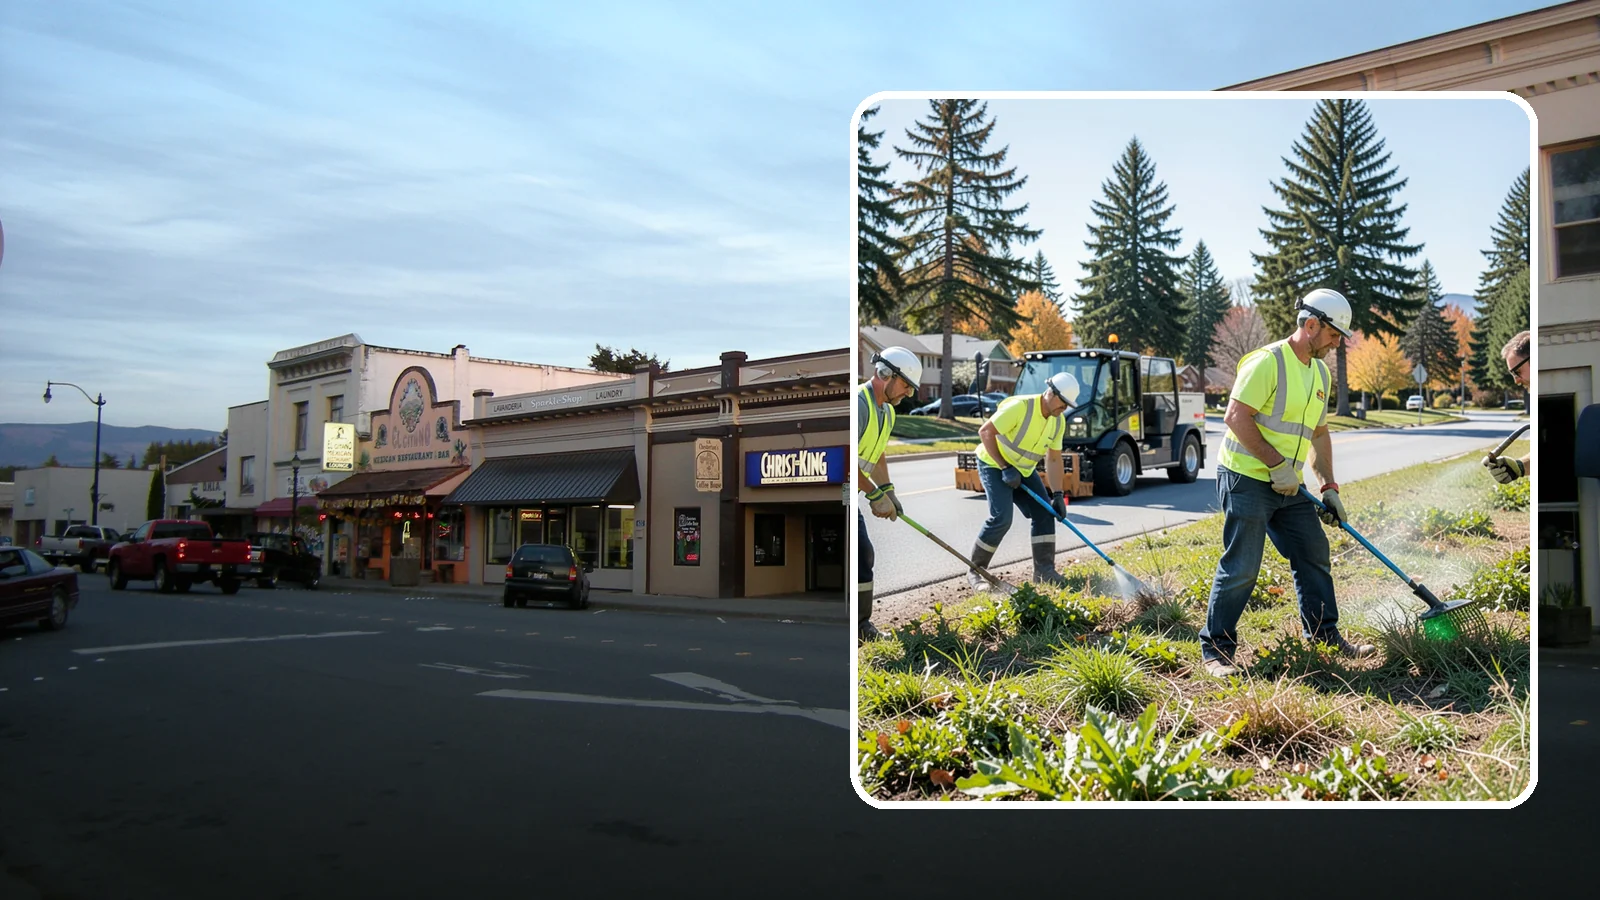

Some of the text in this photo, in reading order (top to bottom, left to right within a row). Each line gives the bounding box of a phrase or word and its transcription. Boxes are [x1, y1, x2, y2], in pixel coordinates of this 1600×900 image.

[561, 394, 583, 406] Shop
[595, 389, 623, 400] LAUNDRY
[493, 402, 523, 413] LAVANDERIA
[373, 454, 396, 464] MEXICAN
[397, 451, 433, 462] RESTAURANT
[438, 450, 450, 459] BAR
[760, 449, 827, 478] CHRIST KING
